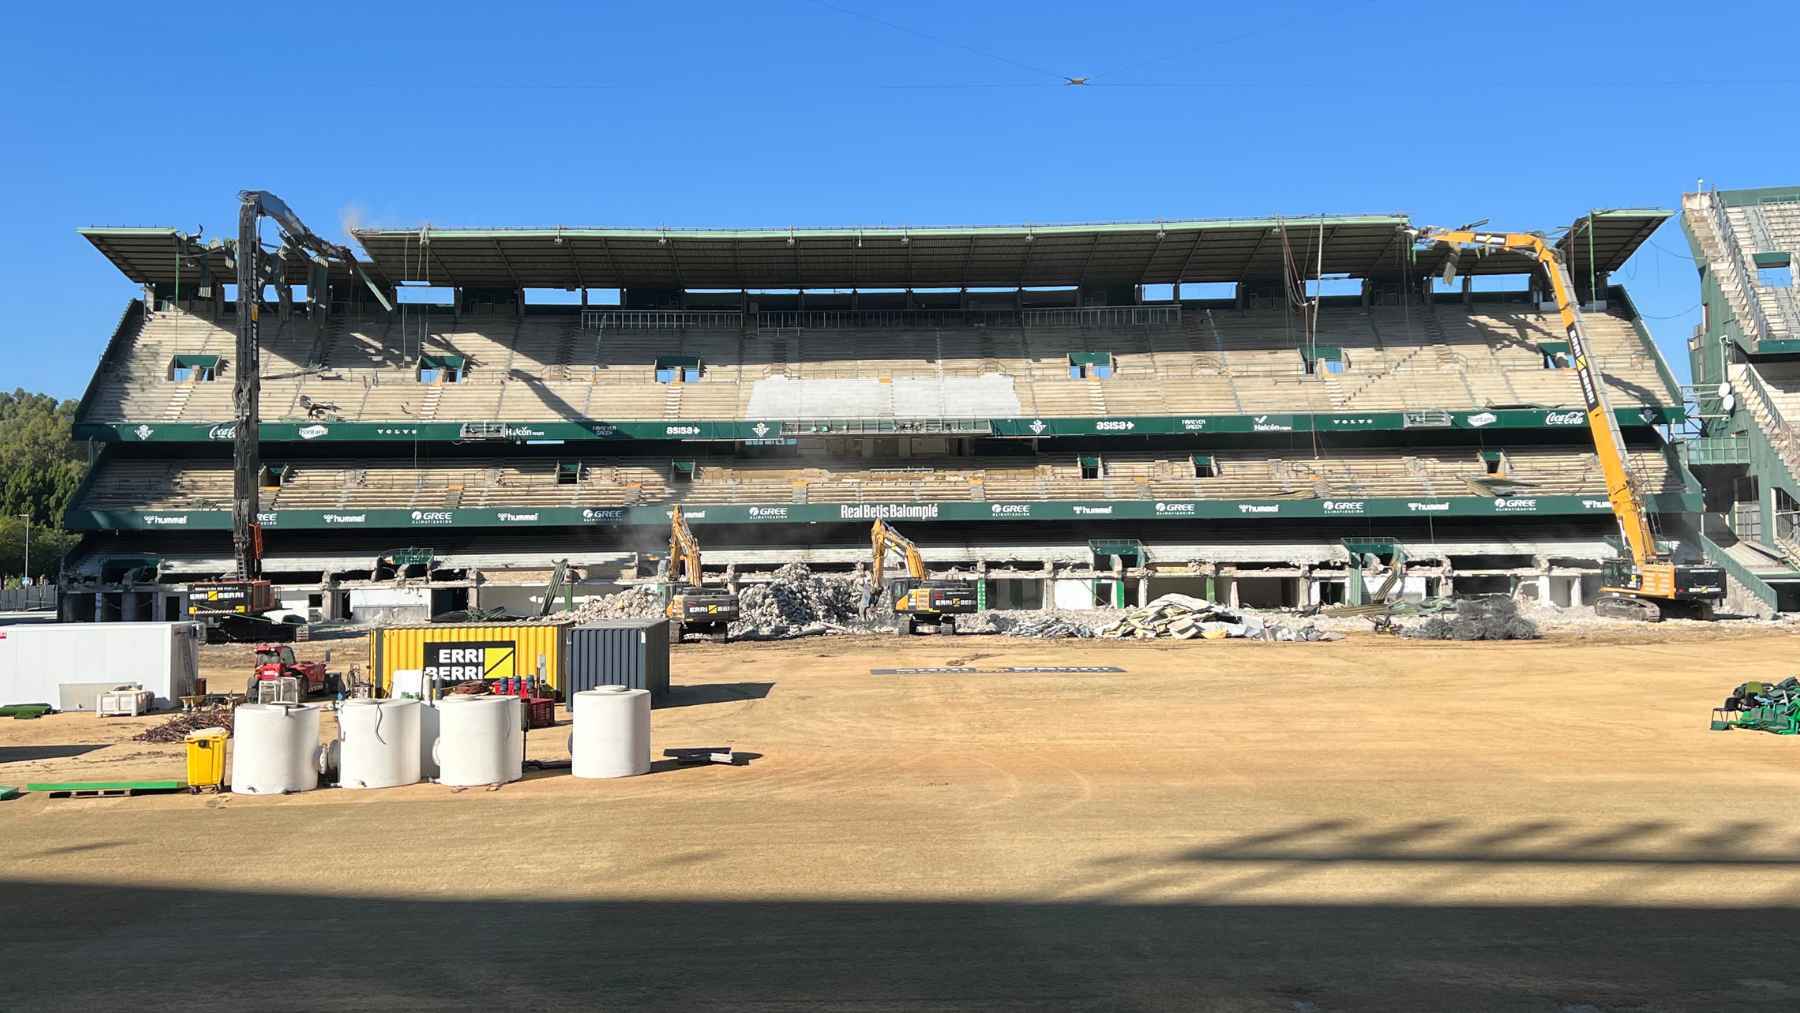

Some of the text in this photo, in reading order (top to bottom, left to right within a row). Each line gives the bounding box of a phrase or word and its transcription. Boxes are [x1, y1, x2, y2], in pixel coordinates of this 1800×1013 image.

[1546, 412, 1584, 425] Coca-Cola
[666, 426, 693, 435] asisa
[1096, 422, 1126, 430] asisa
[1418, 502, 1450, 510] hummel
[840, 504, 863, 518] Real
[864, 504, 889, 518] Betis
[154, 516, 188, 524] hummel
[334, 514, 366, 522] hummel
[438, 648, 483, 663] ERRI
[424, 666, 483, 680] BERRI
